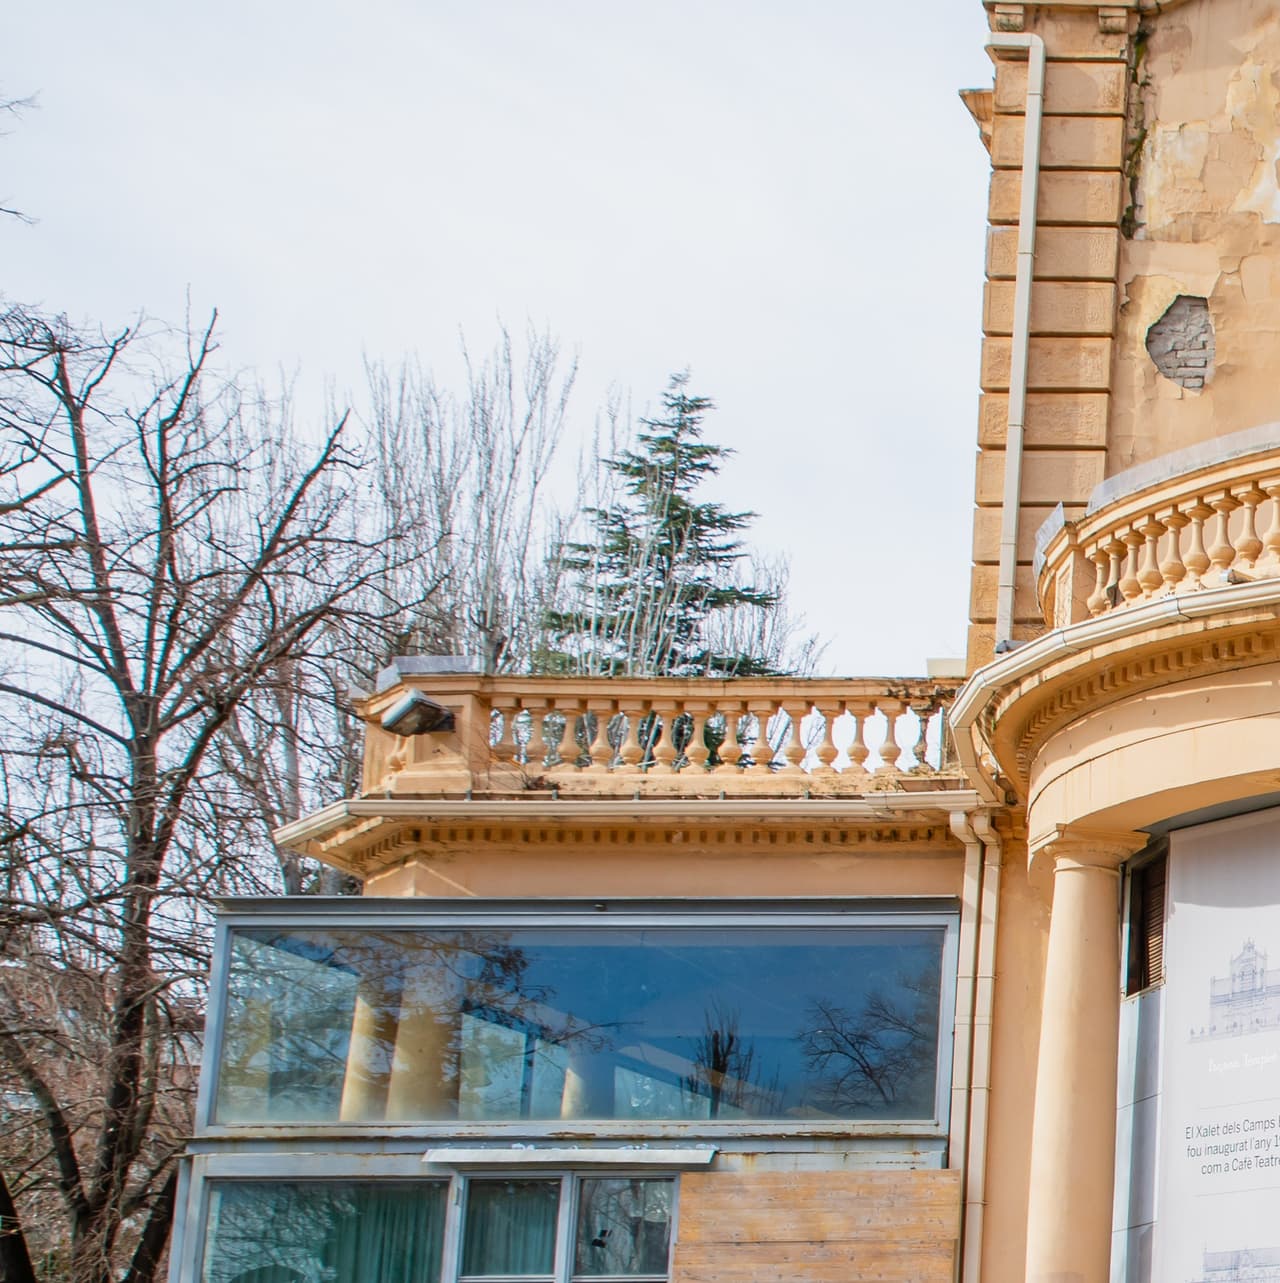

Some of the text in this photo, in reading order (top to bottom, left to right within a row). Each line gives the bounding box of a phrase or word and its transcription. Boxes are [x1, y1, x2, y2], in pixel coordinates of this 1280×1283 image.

[1185, 1126, 1194, 1140] El
[1196, 1123, 1220, 1138] Xalet
[1222, 1121, 1241, 1136] dels
[1243, 1118, 1276, 1133] Camps
[1187, 1144, 1202, 1158] fou
[1204, 1139, 1248, 1157] inaugurat
[1201, 1163, 1222, 1175] com
[1224, 1161, 1230, 1172] a
